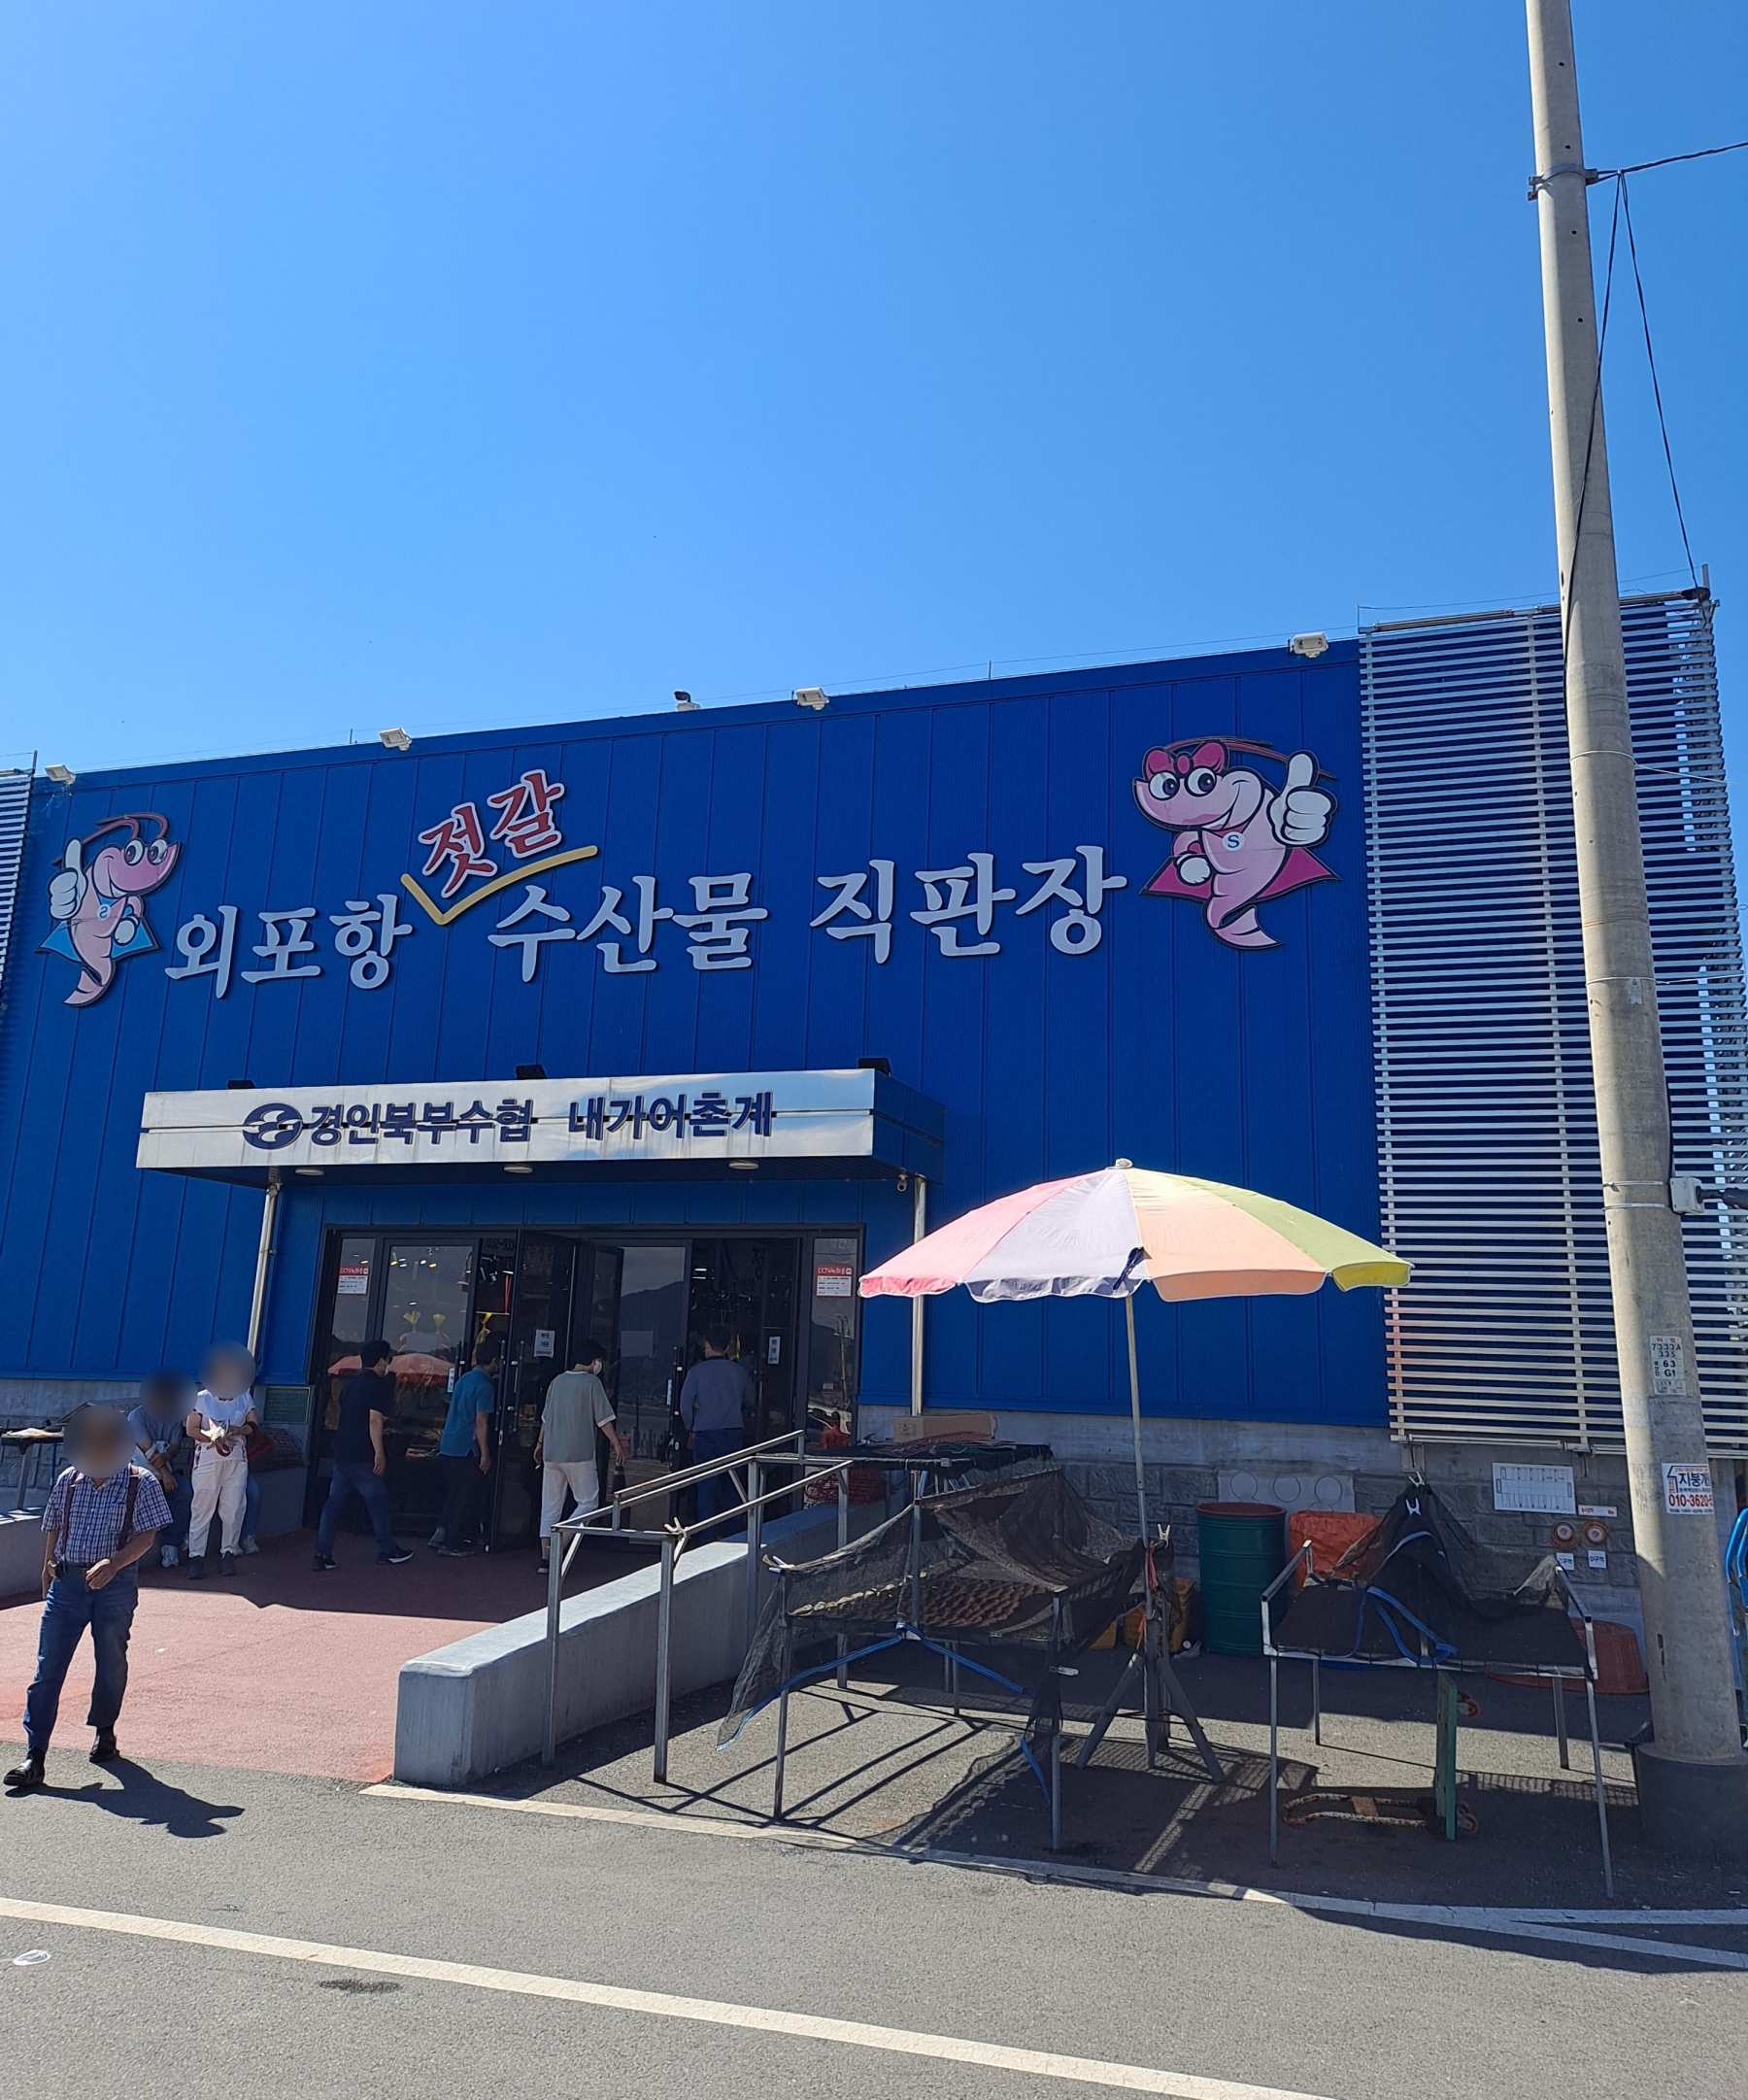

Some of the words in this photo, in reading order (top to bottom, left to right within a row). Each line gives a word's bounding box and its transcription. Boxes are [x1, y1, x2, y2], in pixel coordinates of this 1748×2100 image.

[420, 768, 565, 899] 젓갈
[1227, 833, 1240, 848] S
[165, 894, 413, 999] 외포항
[487, 872, 768, 983] 수산물
[810, 845, 1127, 965] 직판장
[309, 1099, 533, 1145] 경인북부수협
[568, 1091, 774, 1140] 내가어촌계
